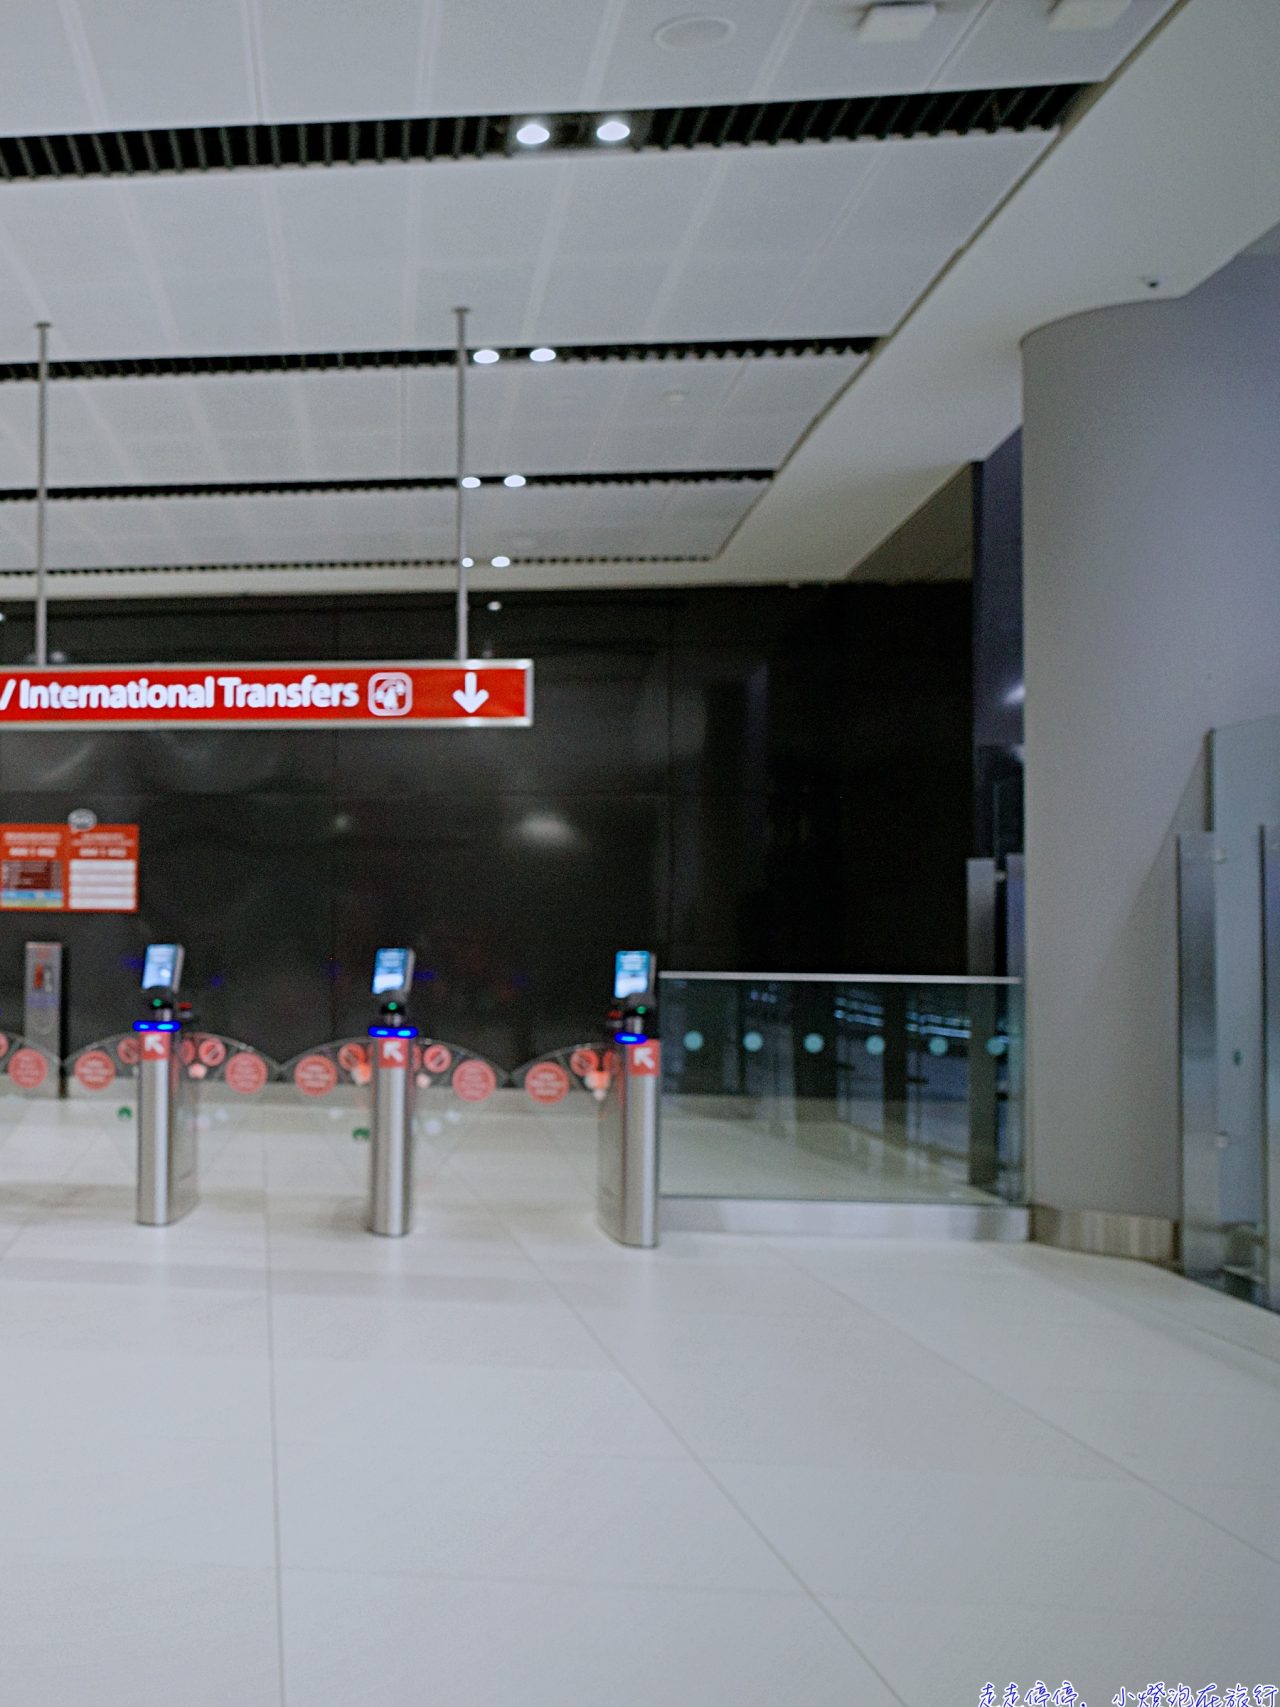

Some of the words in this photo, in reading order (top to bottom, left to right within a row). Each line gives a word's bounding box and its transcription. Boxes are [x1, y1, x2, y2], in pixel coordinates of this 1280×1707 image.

[0, 679, 16, 709] /
[20, 677, 214, 708] International
[218, 675, 359, 707] Transfers
